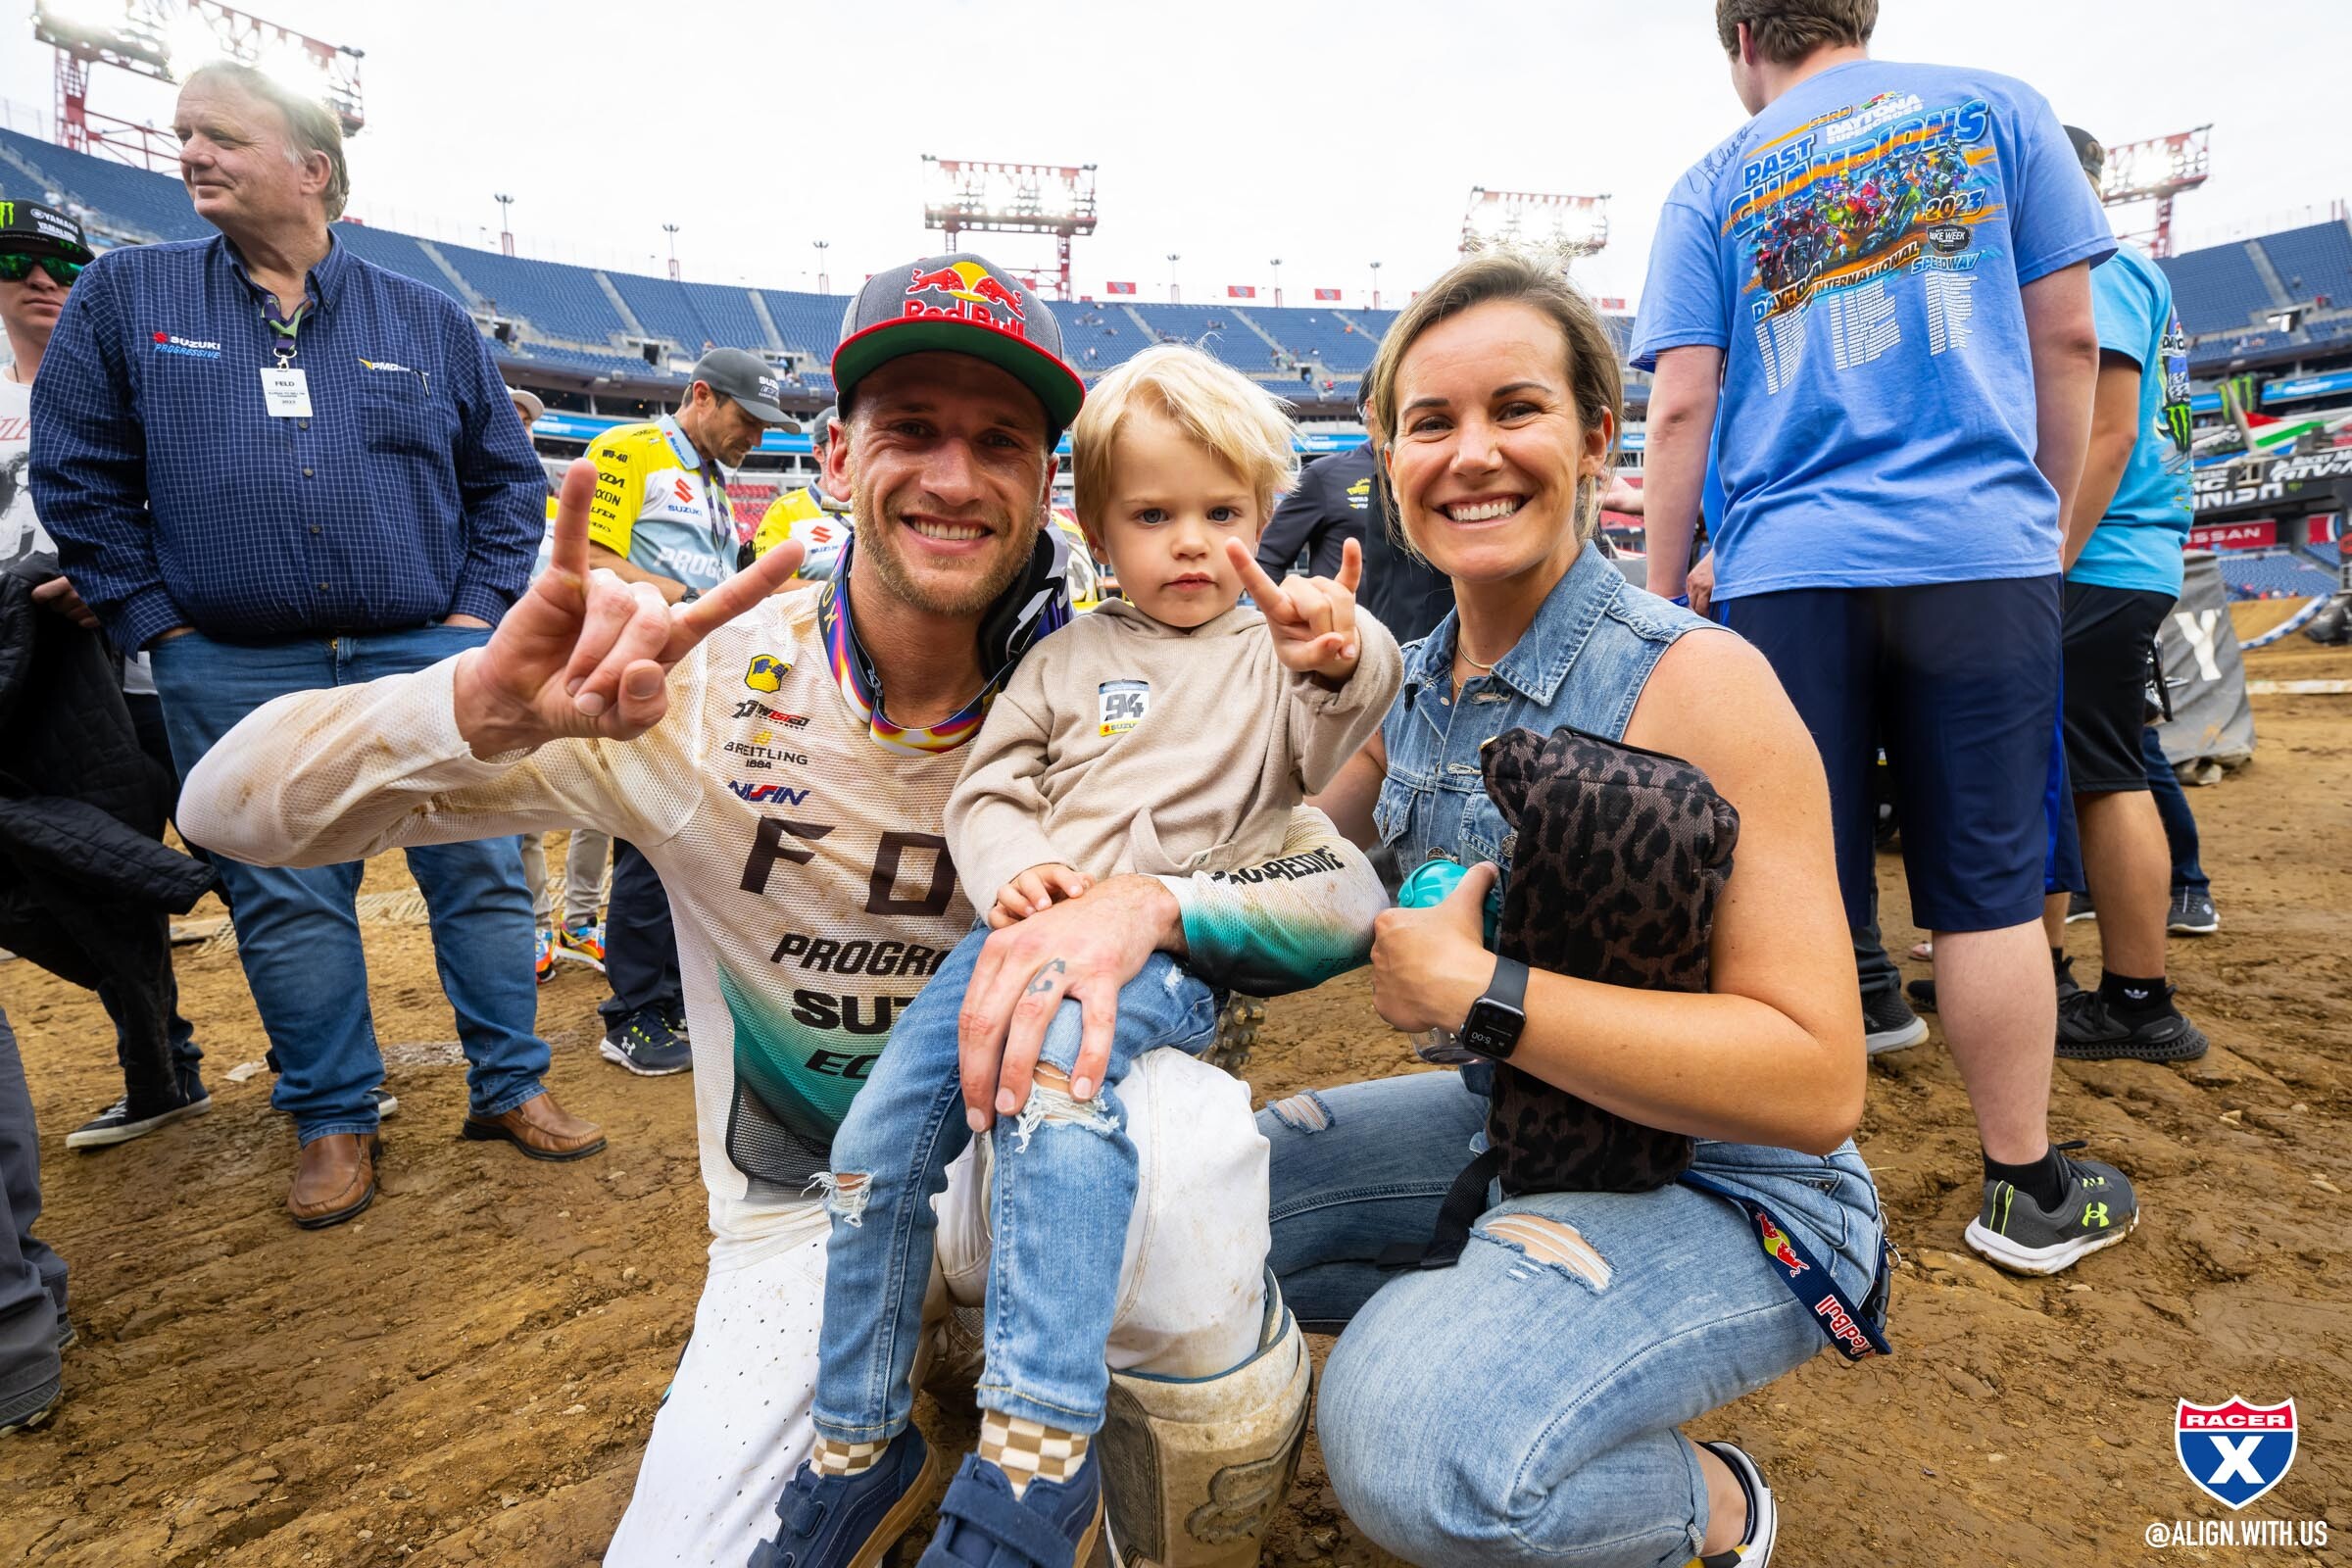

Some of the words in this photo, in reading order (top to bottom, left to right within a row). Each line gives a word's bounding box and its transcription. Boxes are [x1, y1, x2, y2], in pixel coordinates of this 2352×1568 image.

[1826, 94, 1923, 138] DAYTONA
[1728, 99, 1990, 240] CHAMPIONS
[1742, 133, 1818, 191] PAST
[1925, 188, 1986, 221] 2023
[43, 213, 79, 234] YAMAHA
[1945, 231, 1965, 241] WEEK
[1751, 261, 1824, 324] DAYTONA
[1812, 241, 1921, 295] INTERNATIONAL
[1911, 252, 1982, 275] SPEEDWAY
[154, 343, 221, 360] PROGRESSIVE
[171, 335, 221, 351] SUZUKI
[667, 504, 704, 517] SUZUKI
[1104, 693, 1145, 722] 94
[723, 741, 808, 766] BREITLING
[745, 759, 772, 770] 1884
